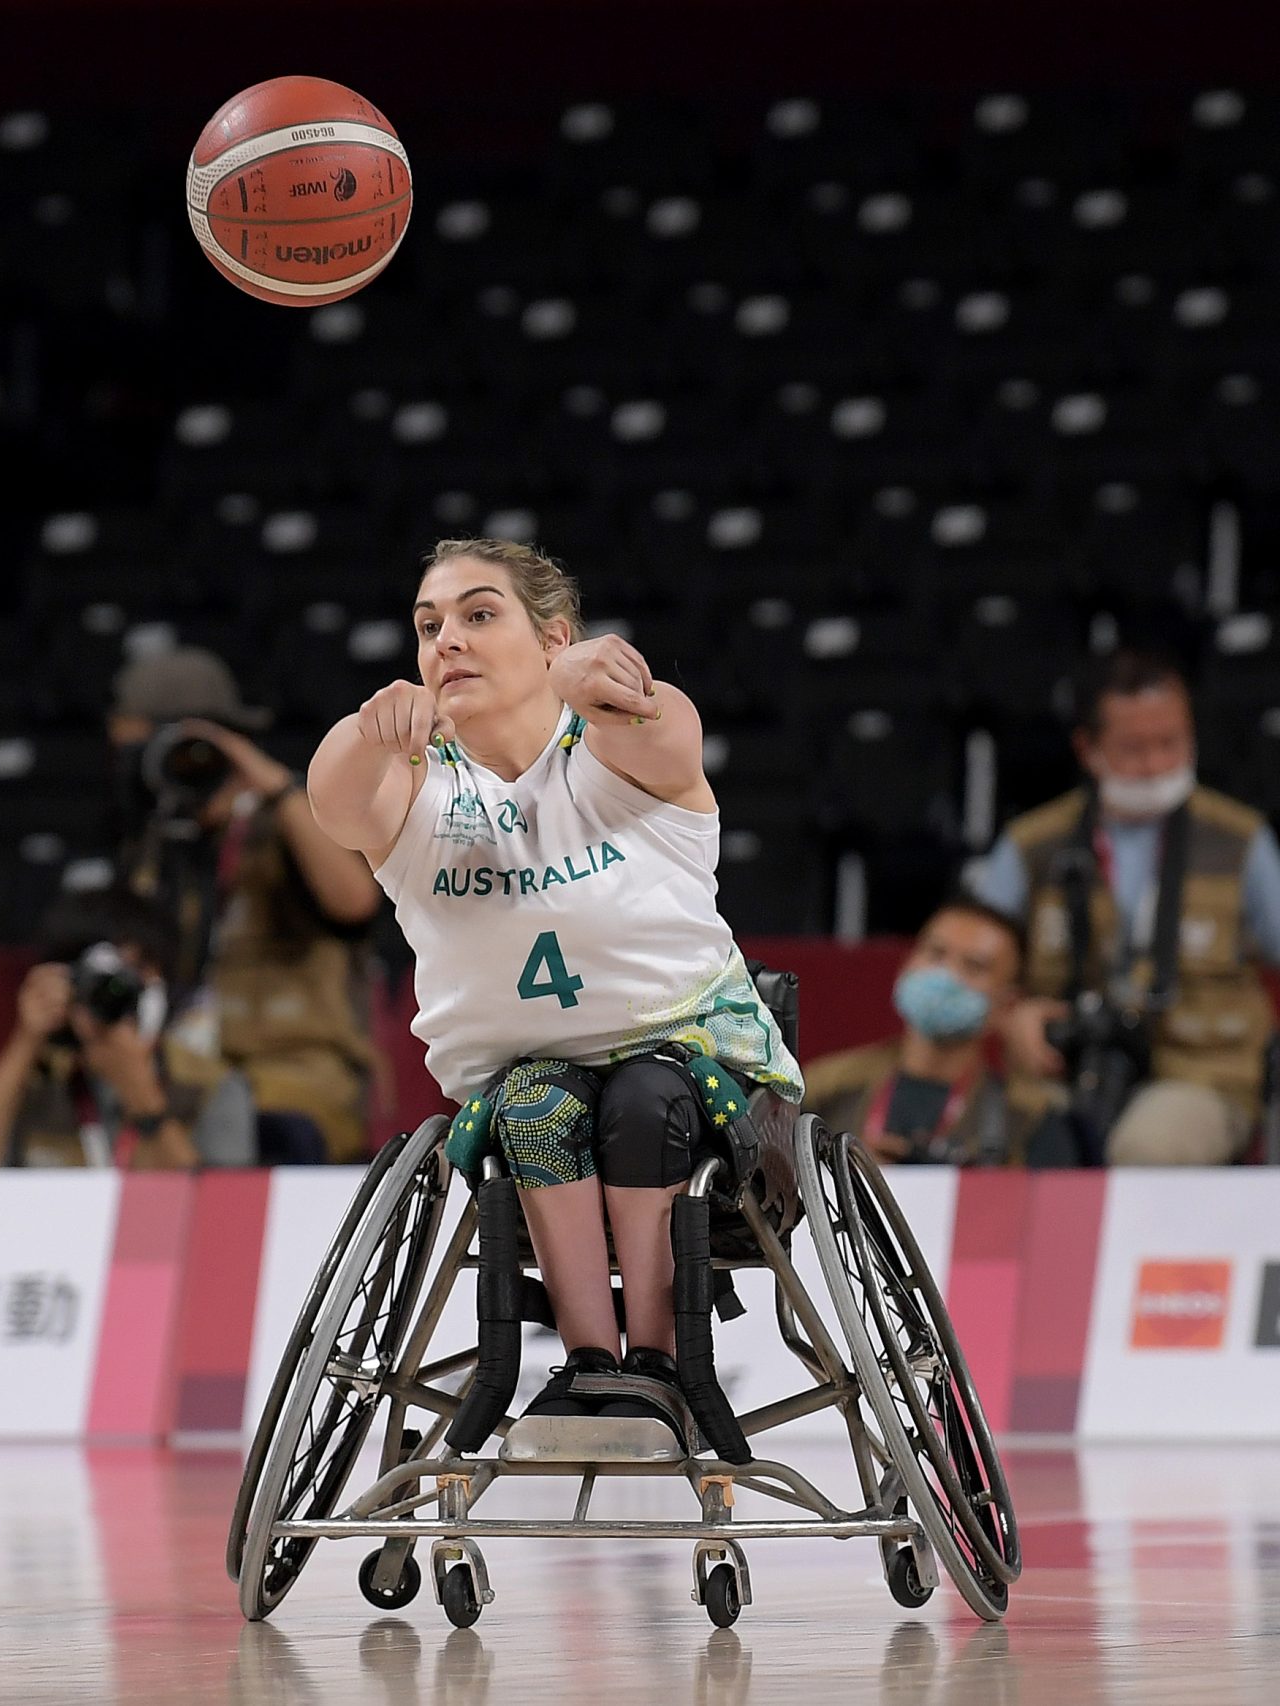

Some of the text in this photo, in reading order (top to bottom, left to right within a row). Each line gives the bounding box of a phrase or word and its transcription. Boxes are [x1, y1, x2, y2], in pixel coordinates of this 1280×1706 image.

[291, 126, 335, 142] BG4500
[289, 180, 328, 198] IWBF
[275, 234, 372, 265] molten
[432, 840, 626, 897] AUSTRALIA
[516, 930, 584, 1010] 4
